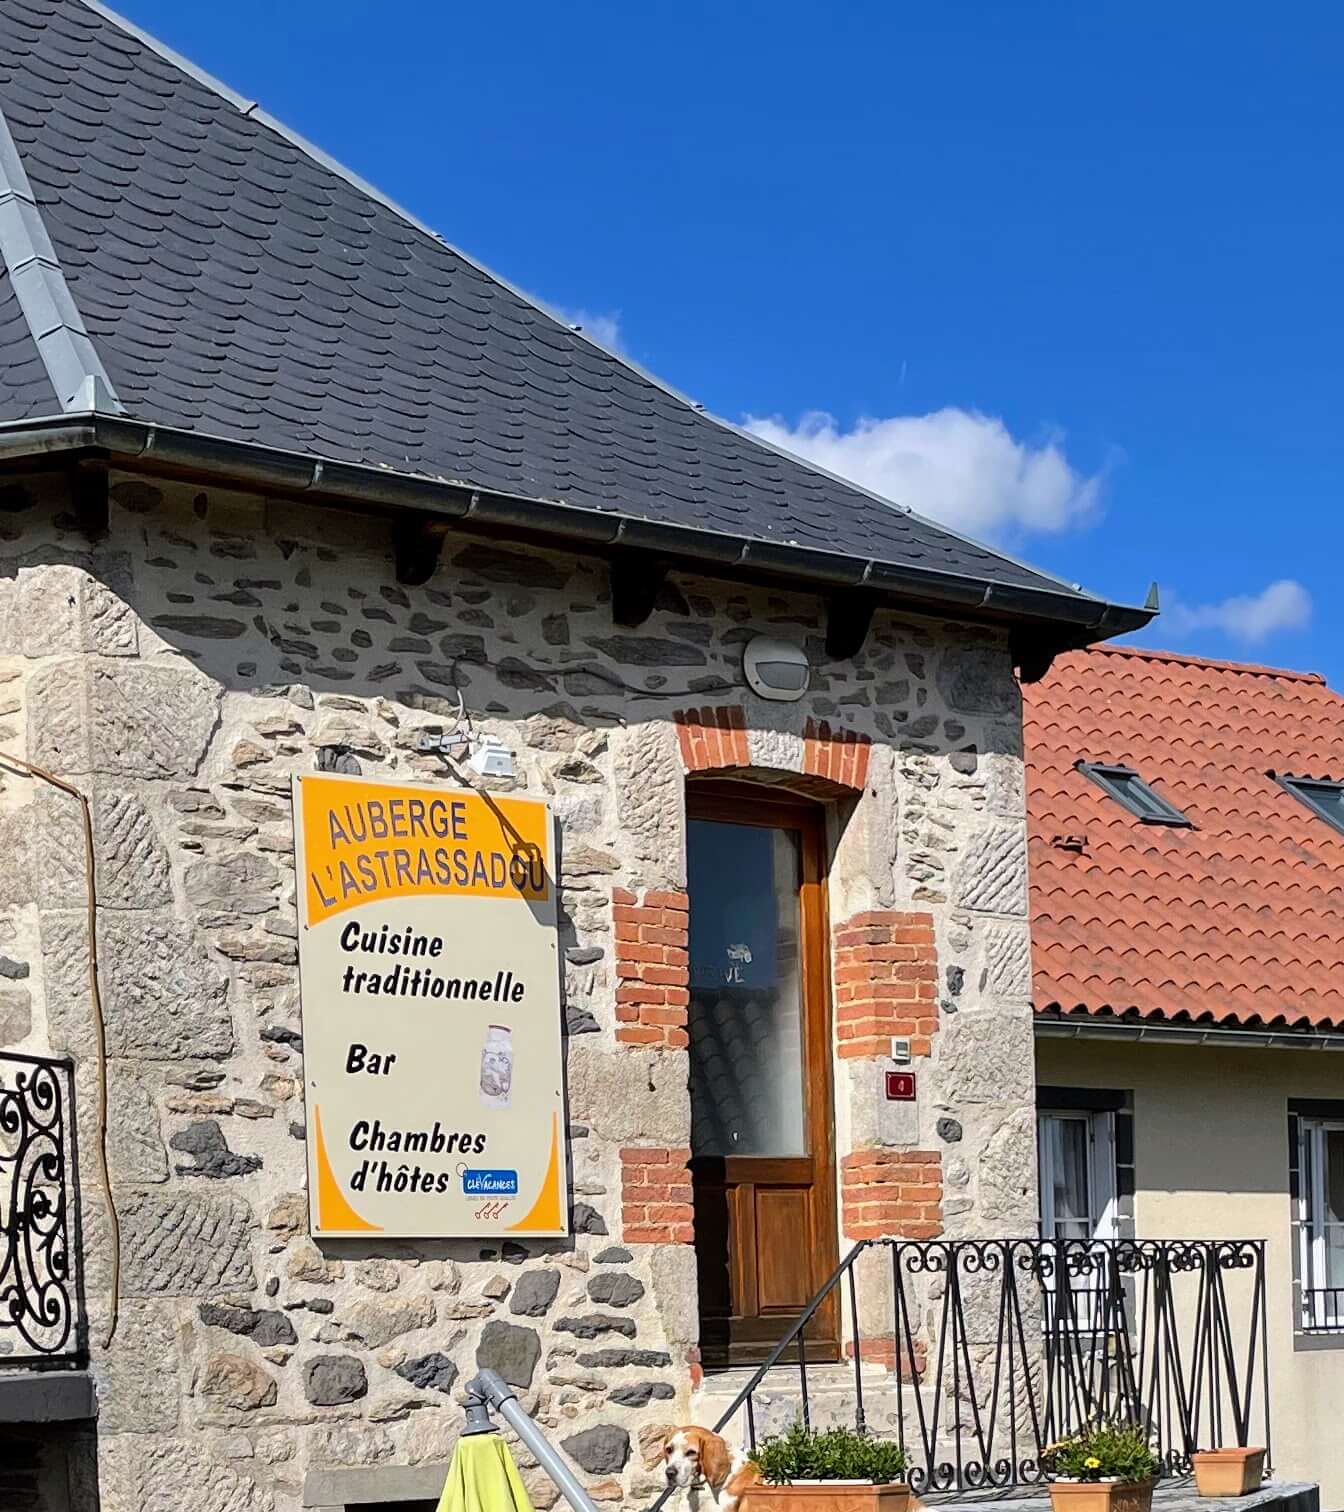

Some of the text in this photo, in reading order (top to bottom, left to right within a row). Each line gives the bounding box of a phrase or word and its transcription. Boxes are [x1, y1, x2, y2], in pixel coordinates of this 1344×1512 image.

[328, 800, 468, 850] AUBERGE
[312, 847, 545, 908] L'ASTRASSADOU
[340, 921, 443, 957] Cuisine
[343, 964, 525, 1003] traditionnelle
[346, 1043, 397, 1075] Bar
[349, 1120, 486, 1154] Chambres
[350, 1160, 449, 1193] d'hôtes
